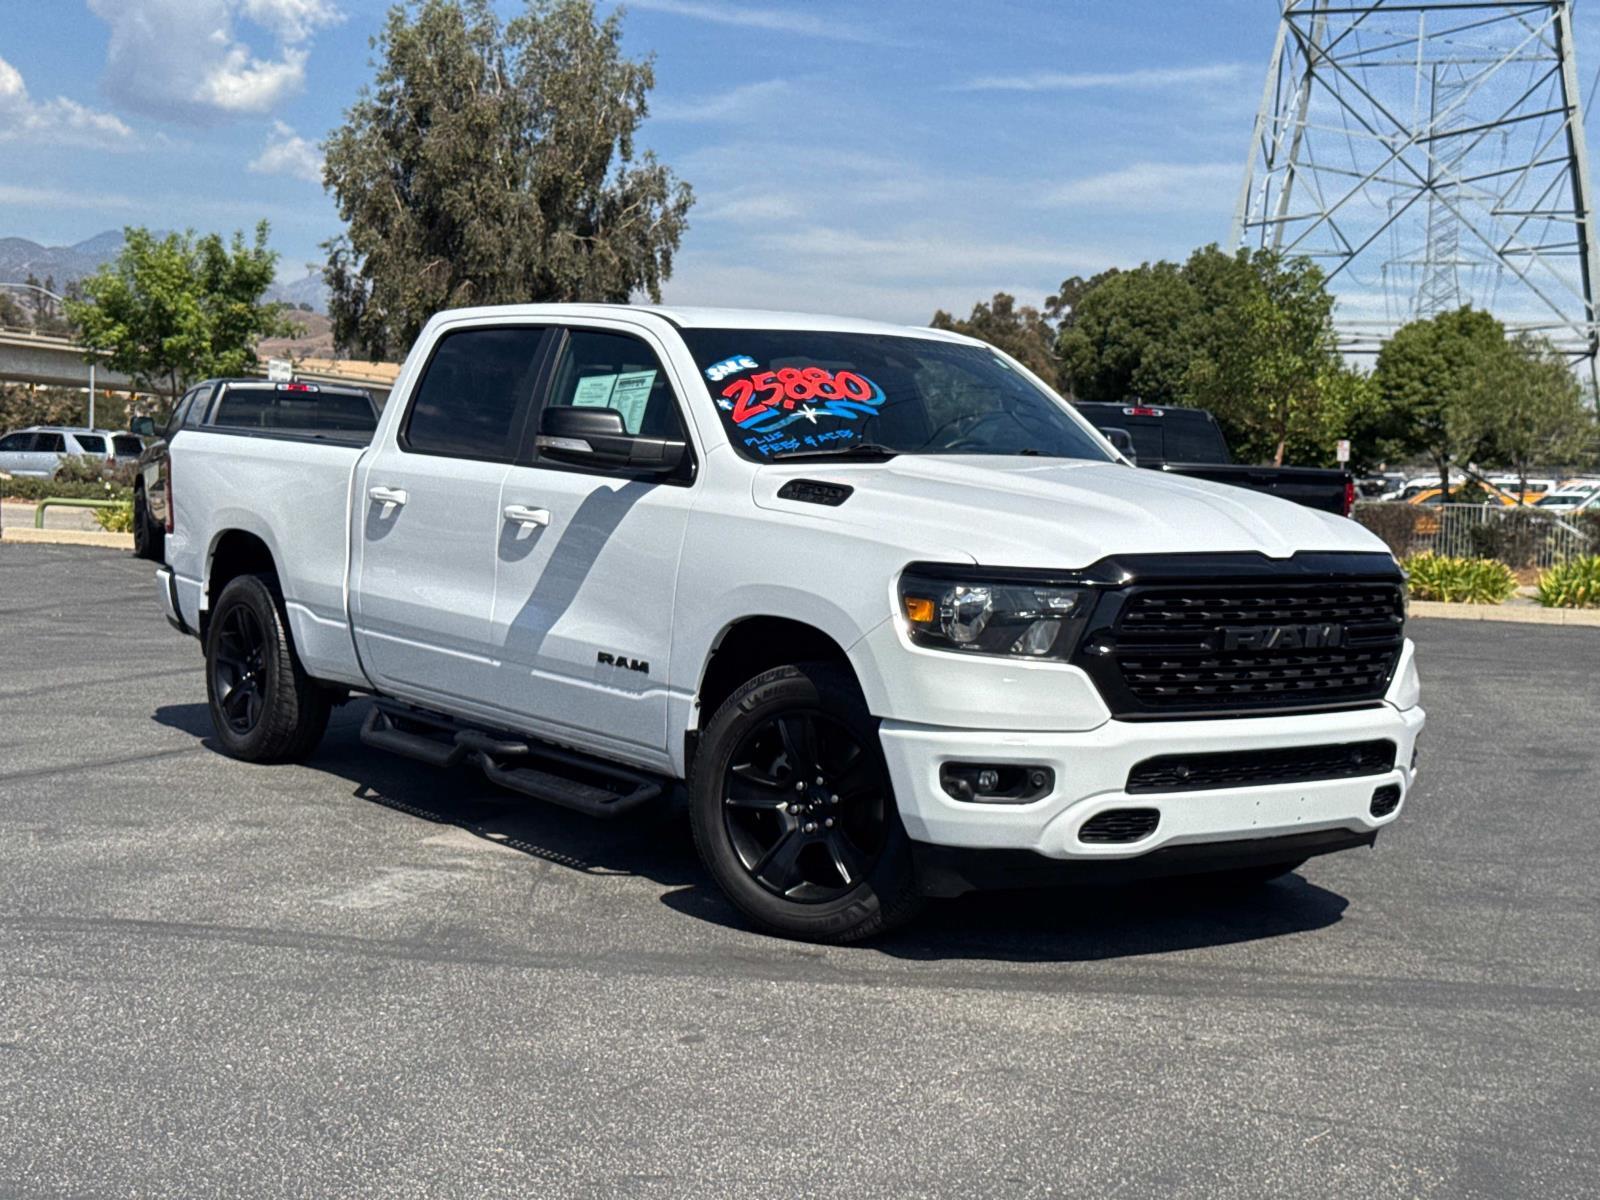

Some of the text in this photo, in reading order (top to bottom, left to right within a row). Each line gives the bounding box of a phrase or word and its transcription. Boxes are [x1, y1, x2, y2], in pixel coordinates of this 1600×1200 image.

[706, 355, 759, 381] SALE
[744, 431, 784, 446] PLUS
[758, 438, 800, 455] FEES
[1224, 624, 1342, 650] RAM
[597, 651, 650, 674] RAM
